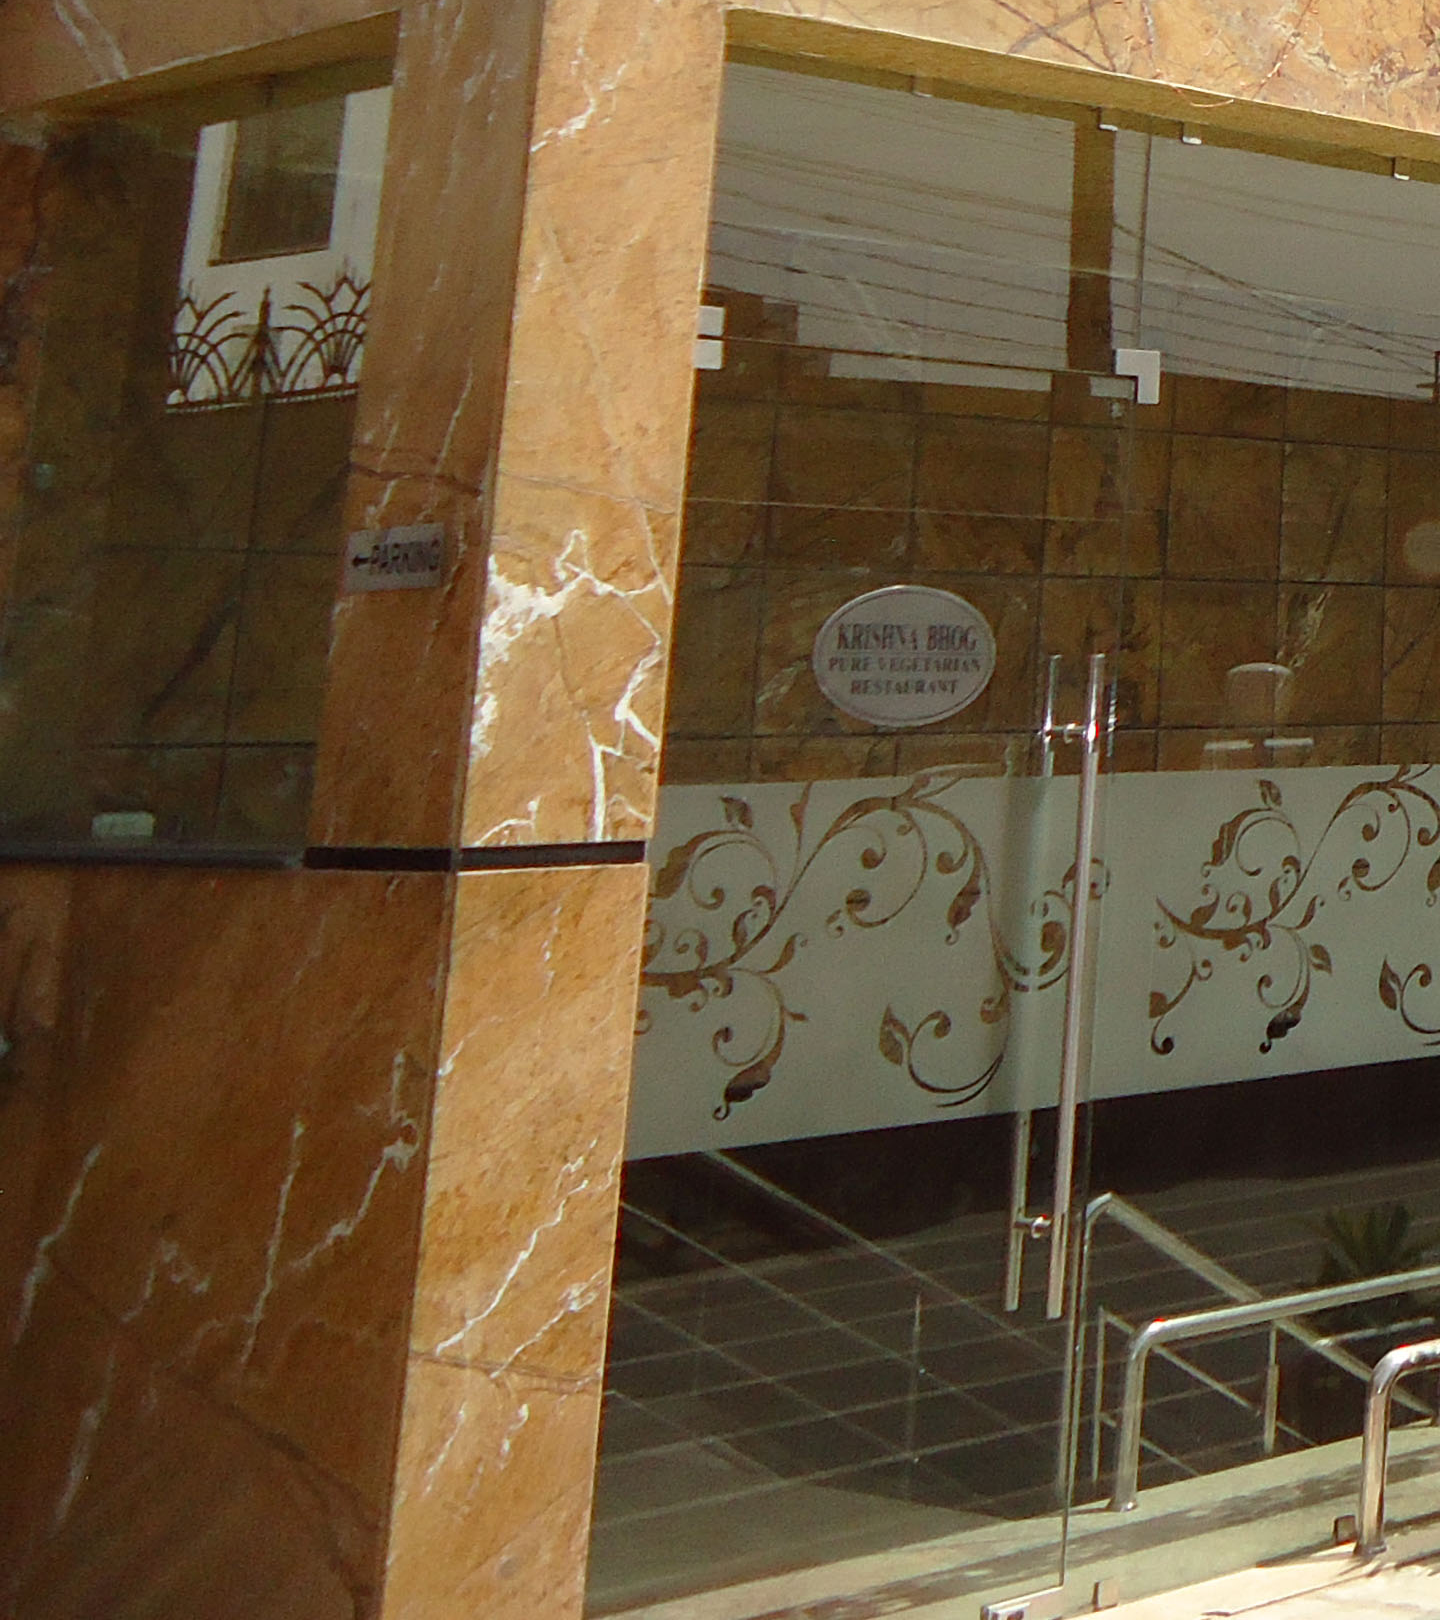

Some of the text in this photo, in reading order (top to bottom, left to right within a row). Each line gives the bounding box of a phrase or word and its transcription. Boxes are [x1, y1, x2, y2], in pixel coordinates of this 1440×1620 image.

[837, 623, 977, 652] KRISHNA BHOG
[829, 656, 981, 672] PURE VEGETARIAN
[851, 679, 958, 694] RESTAURANT
